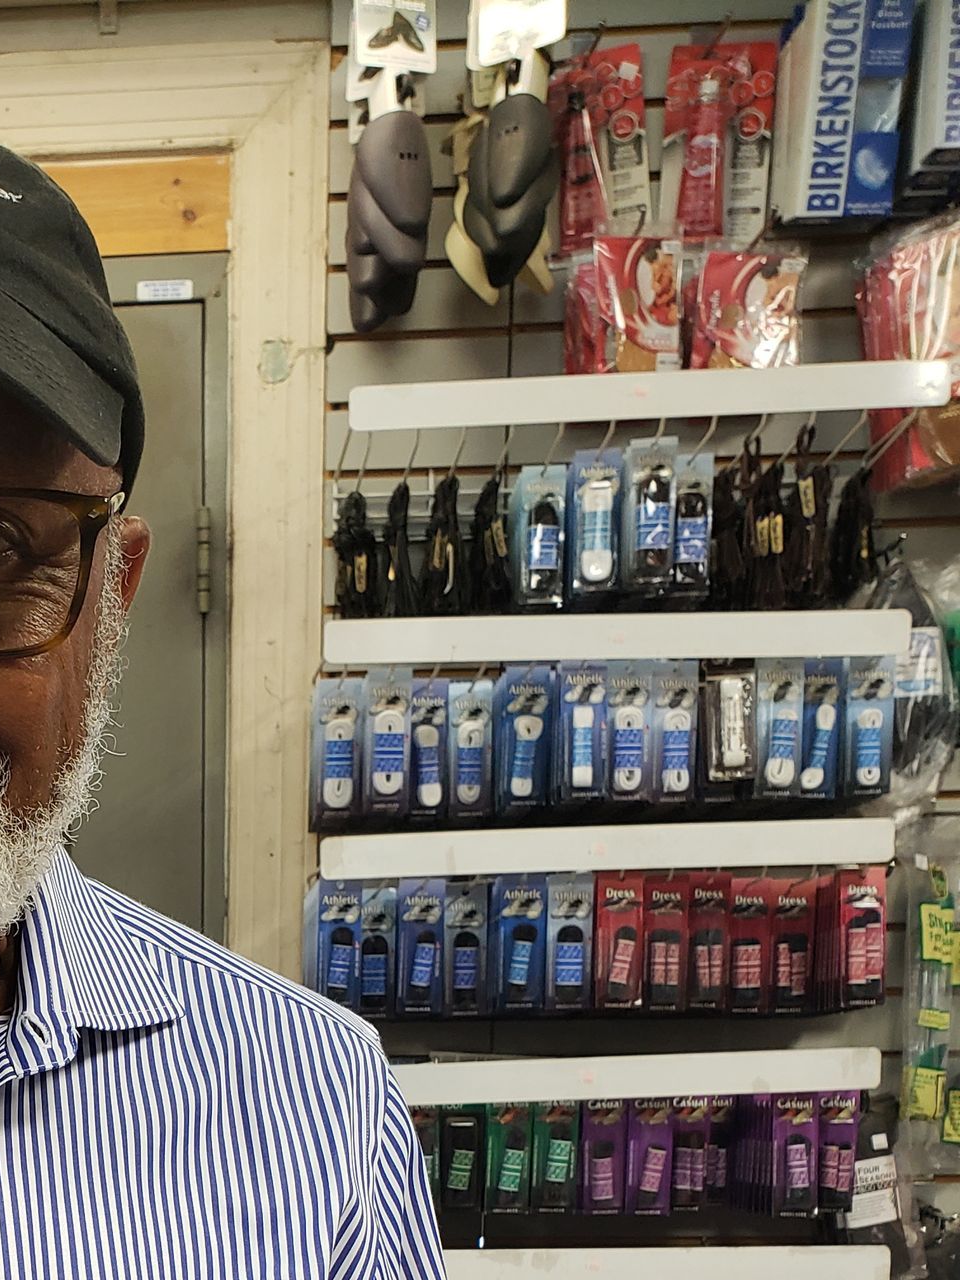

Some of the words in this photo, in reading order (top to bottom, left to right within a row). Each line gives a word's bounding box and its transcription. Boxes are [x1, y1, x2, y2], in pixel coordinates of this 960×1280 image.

[807, 1, 862, 213] BIRKENSTOCK
[565, 674, 604, 685] Athletic
[509, 685, 546, 696] Athletic
[504, 888, 542, 900] Athletic
[606, 887, 636, 900] Dress
[651, 890, 682, 902] Dress
[694, 888, 724, 900] Dress
[848, 884, 878, 896] Dress
[322, 894, 359, 906] Athletic
[403, 895, 441, 907] Athletic
[735, 895, 764, 906] Dress
[778, 895, 808, 907] Dress
[588, 1100, 624, 1111] Casual
[634, 1099, 671, 1111] Casual
[673, 1095, 708, 1109] Casual
[777, 1096, 814, 1110] Casual
[820, 1095, 857, 1109] Casual
